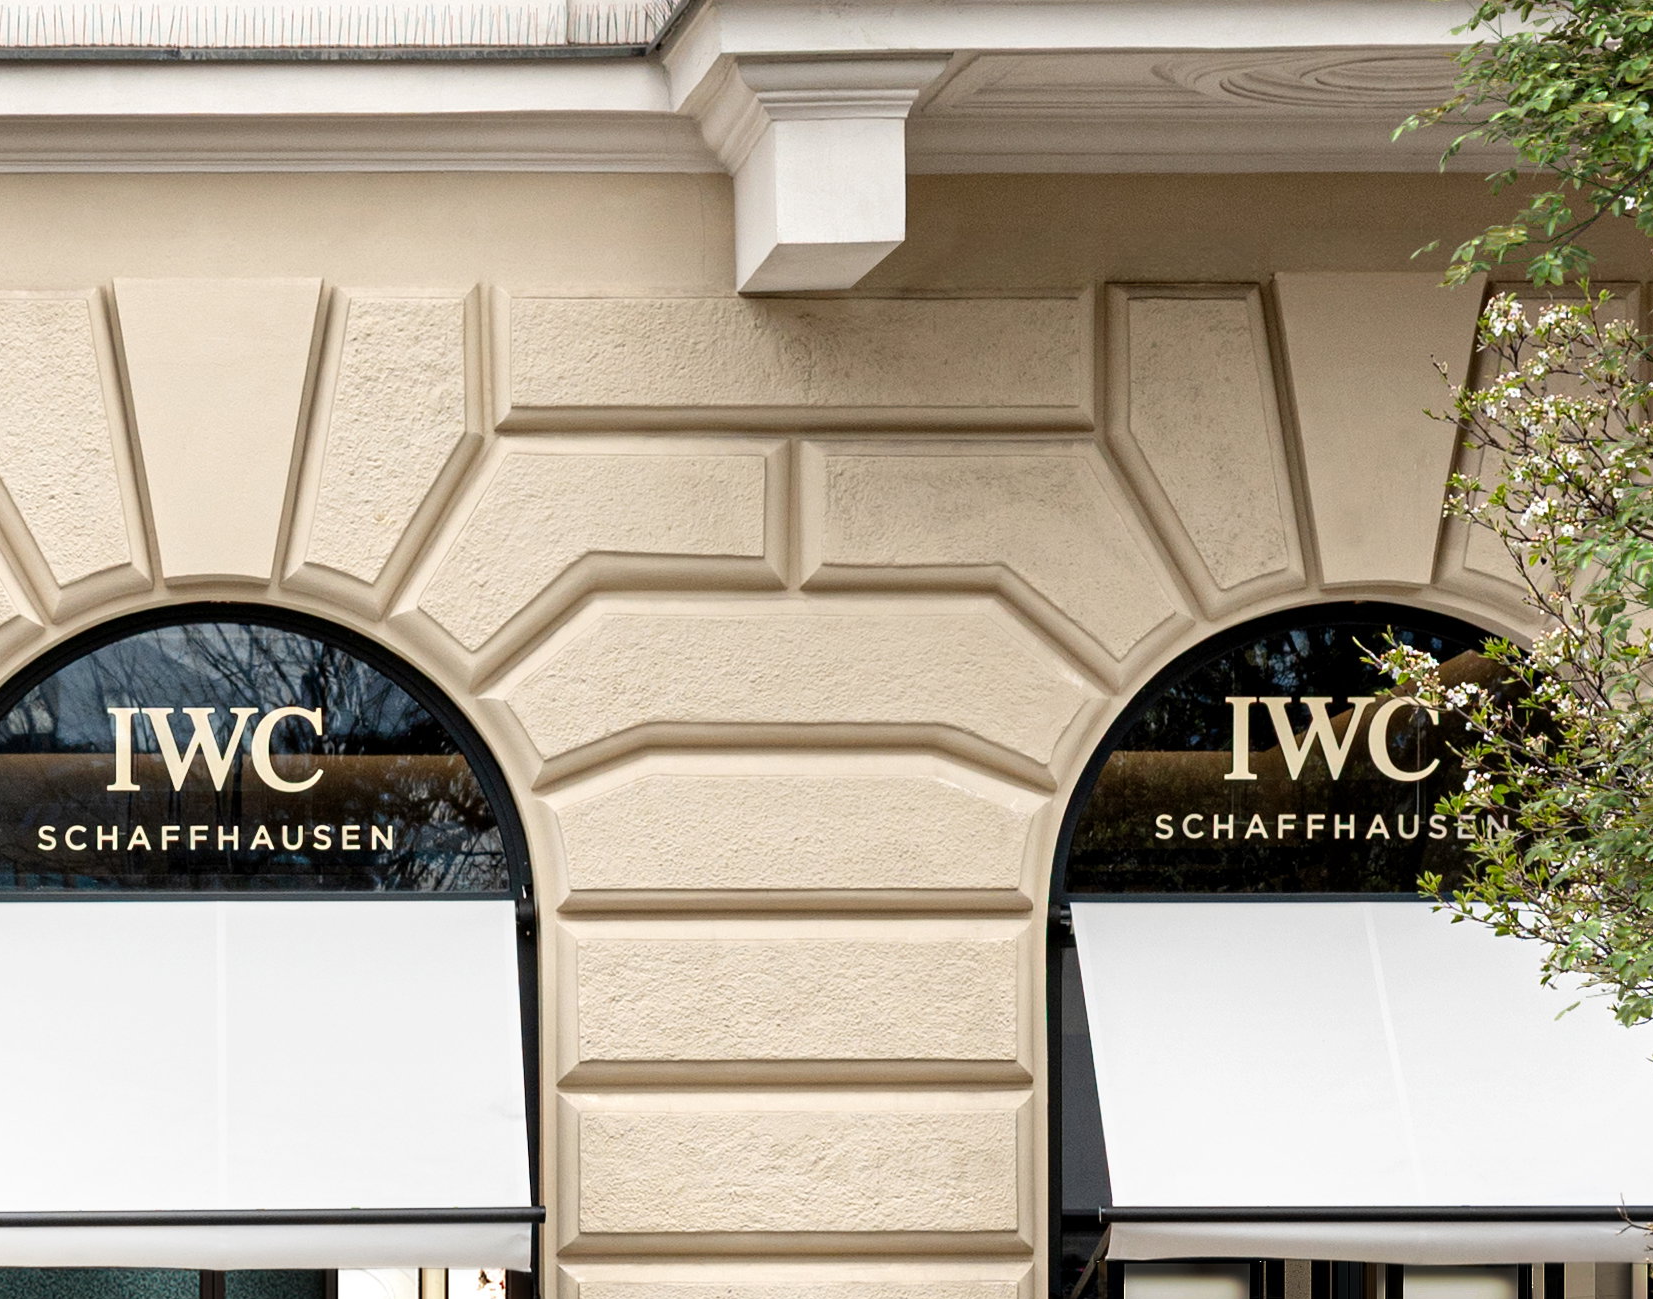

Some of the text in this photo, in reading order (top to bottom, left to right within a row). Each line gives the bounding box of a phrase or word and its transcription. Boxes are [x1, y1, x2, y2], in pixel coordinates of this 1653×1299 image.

[106, 706, 324, 792] IWC
[1223, 696, 1440, 782] IWC
[37, 825, 394, 851] SCHAFFHAUSEN
[1155, 814, 1509, 840] SCHAFFHAUSEN
